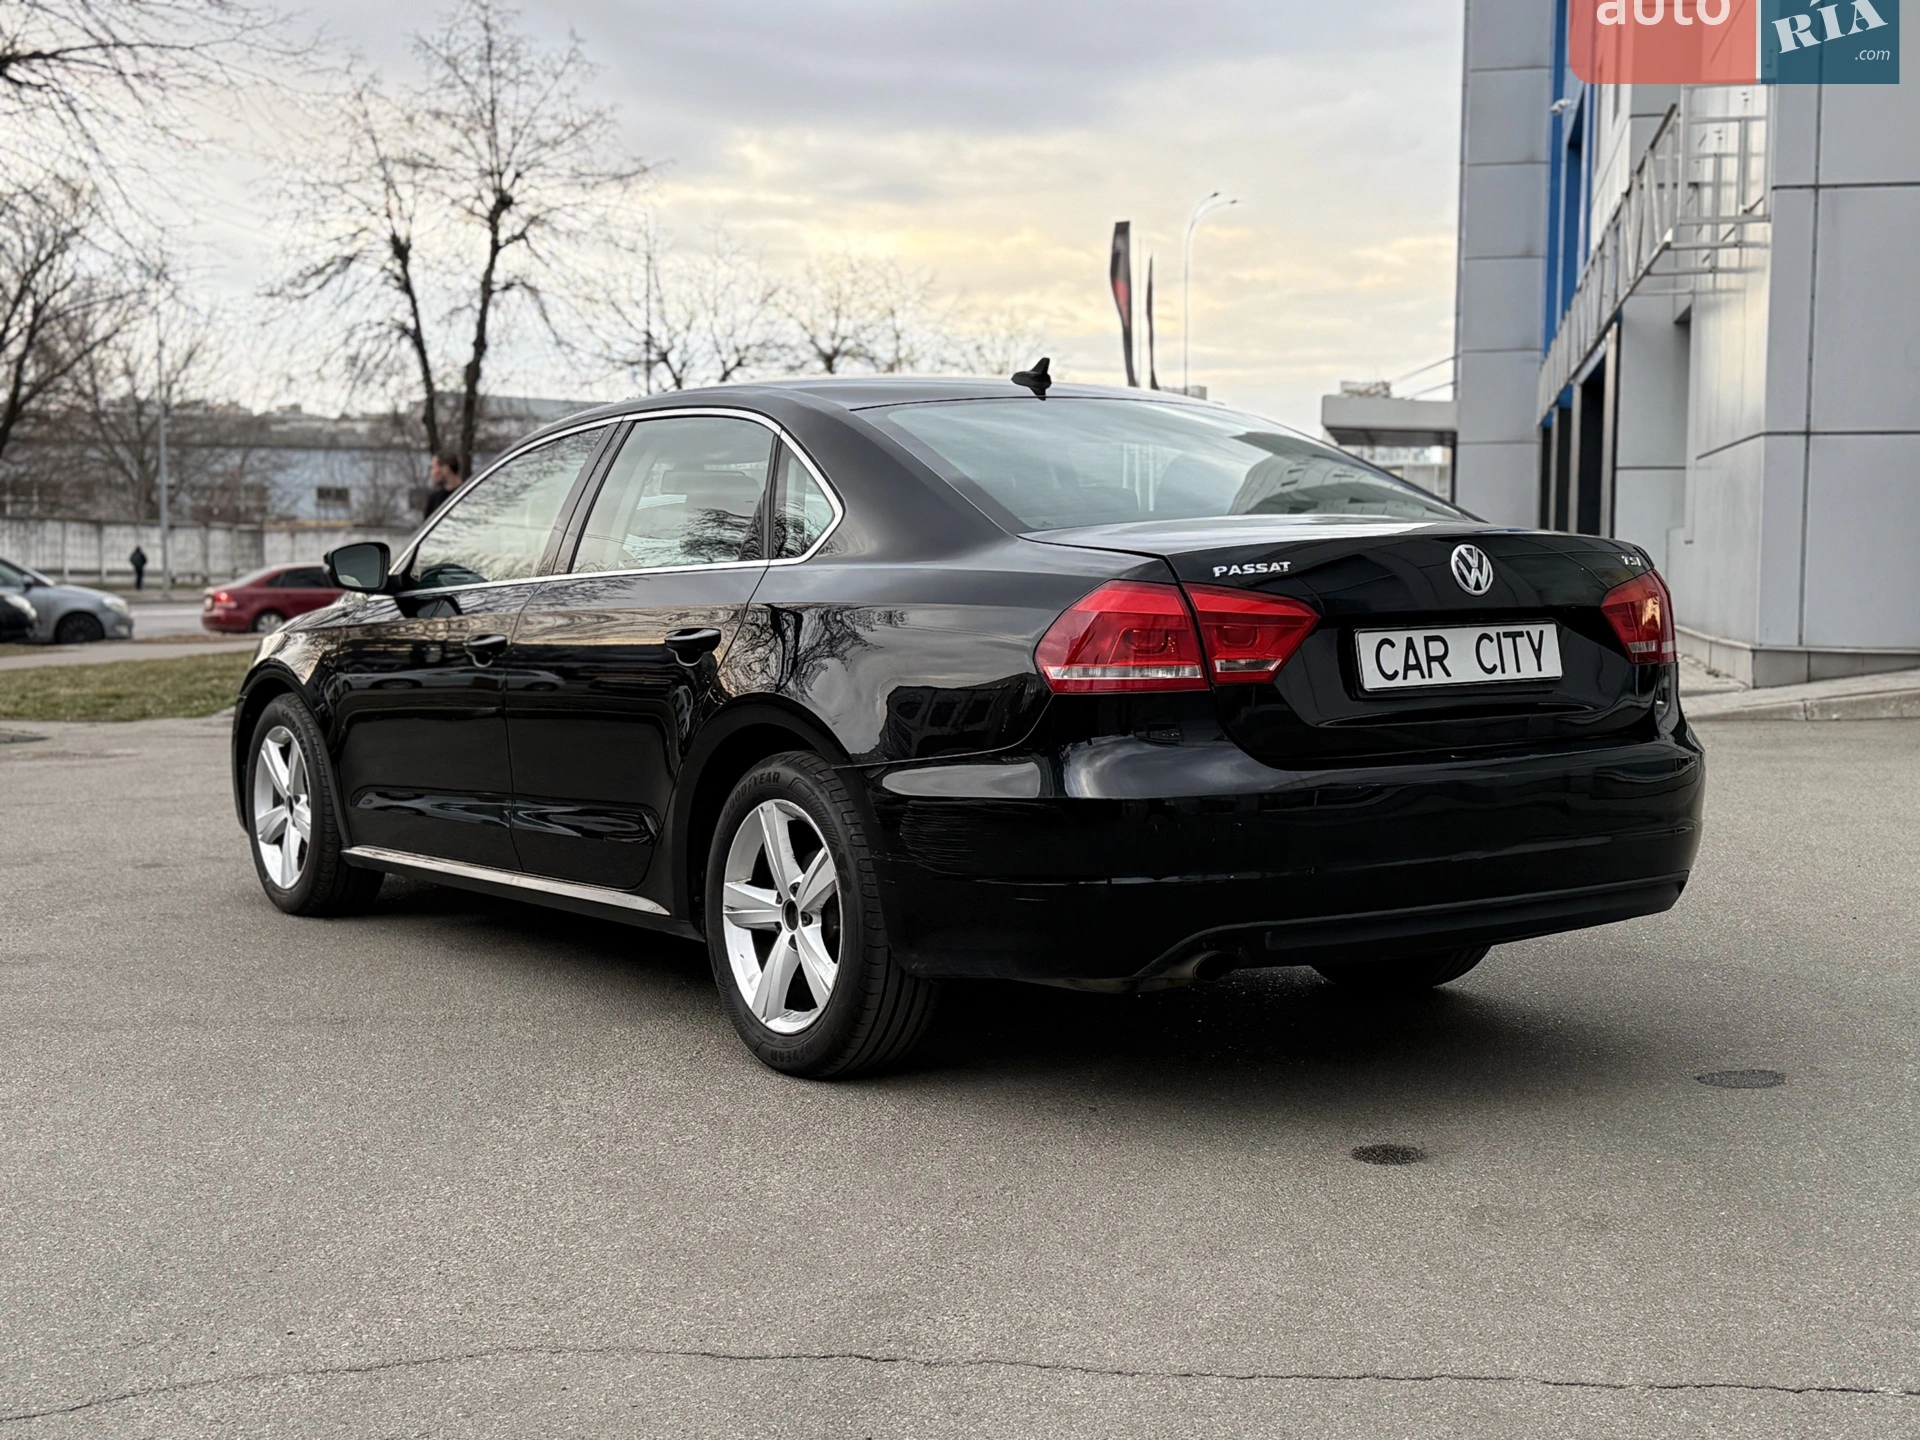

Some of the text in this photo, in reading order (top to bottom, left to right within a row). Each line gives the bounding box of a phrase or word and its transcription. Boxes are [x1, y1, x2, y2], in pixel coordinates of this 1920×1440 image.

[1213, 561, 1291, 577] PASSAT
[1375, 629, 1544, 681] CAR CITY
